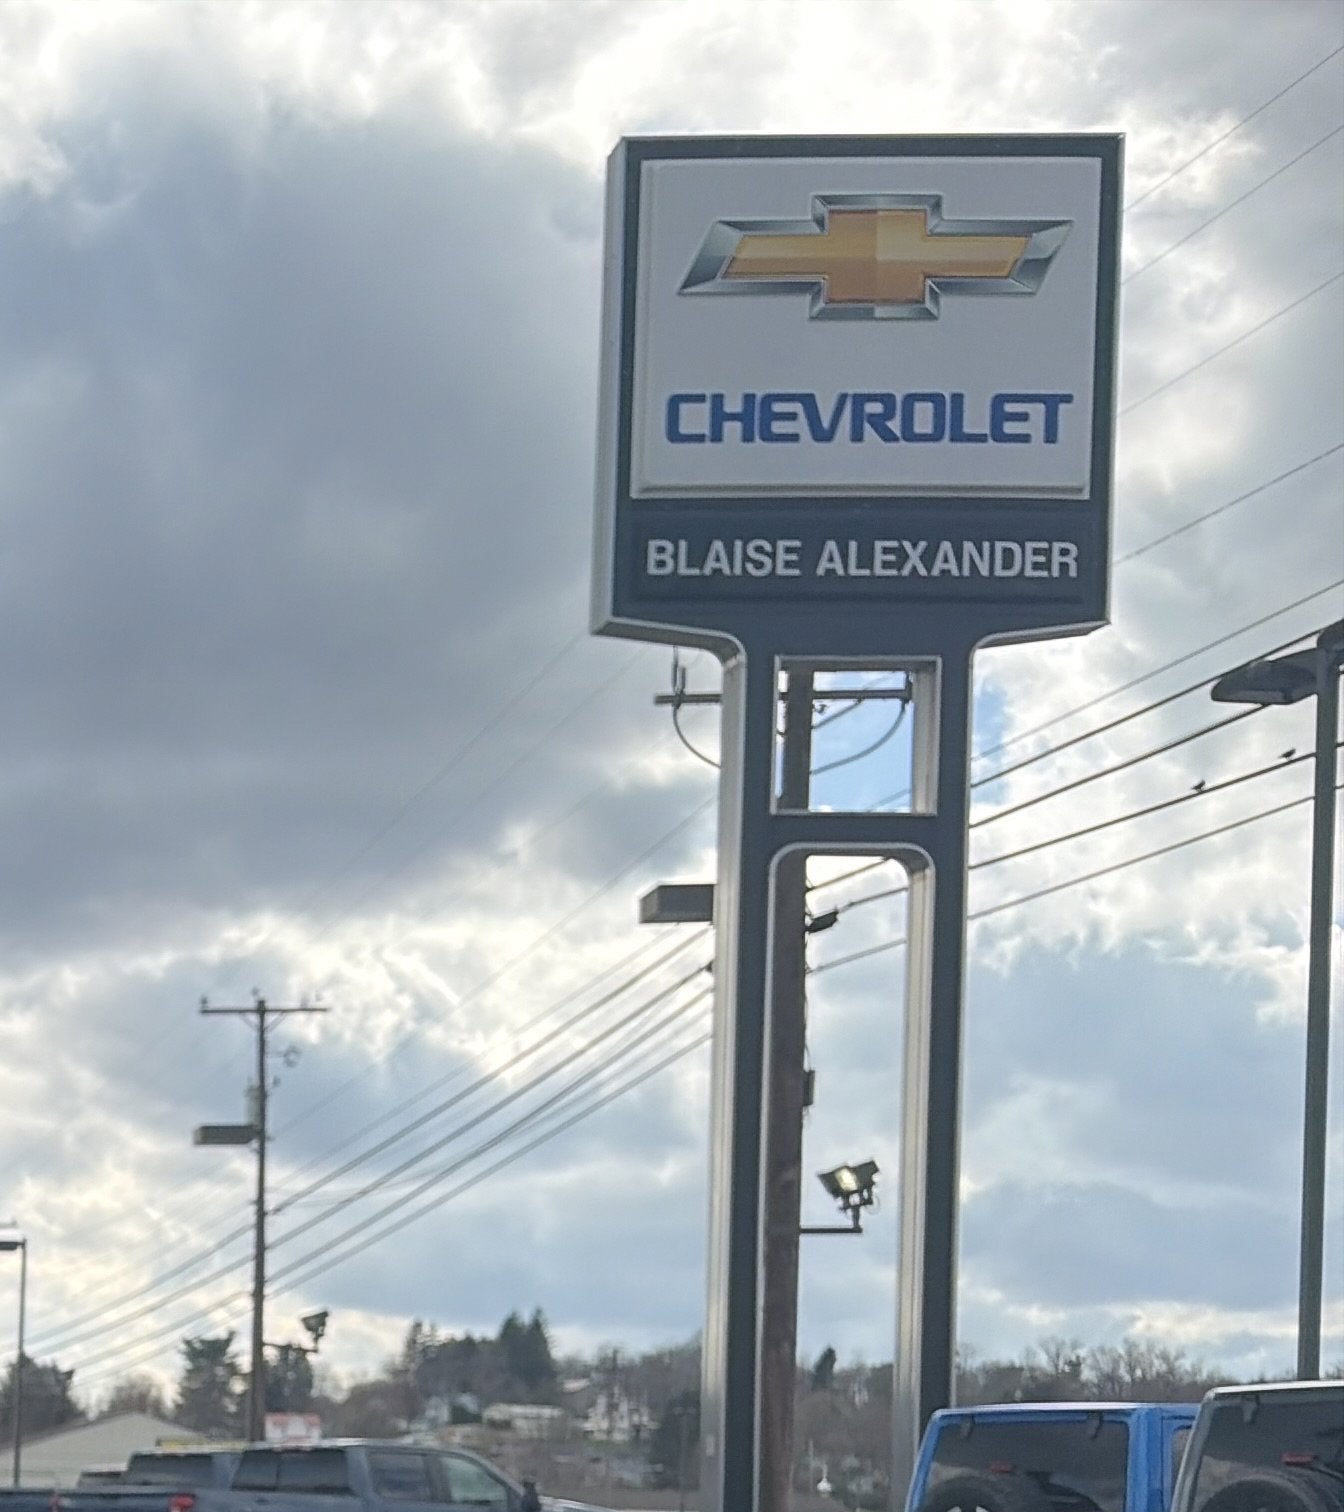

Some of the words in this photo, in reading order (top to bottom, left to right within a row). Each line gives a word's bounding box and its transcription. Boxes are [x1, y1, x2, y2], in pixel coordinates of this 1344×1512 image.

[664, 392, 1075, 444] CHEVROLET
[646, 539, 803, 577] BLAISE
[815, 540, 1079, 578] ALEXANDER
